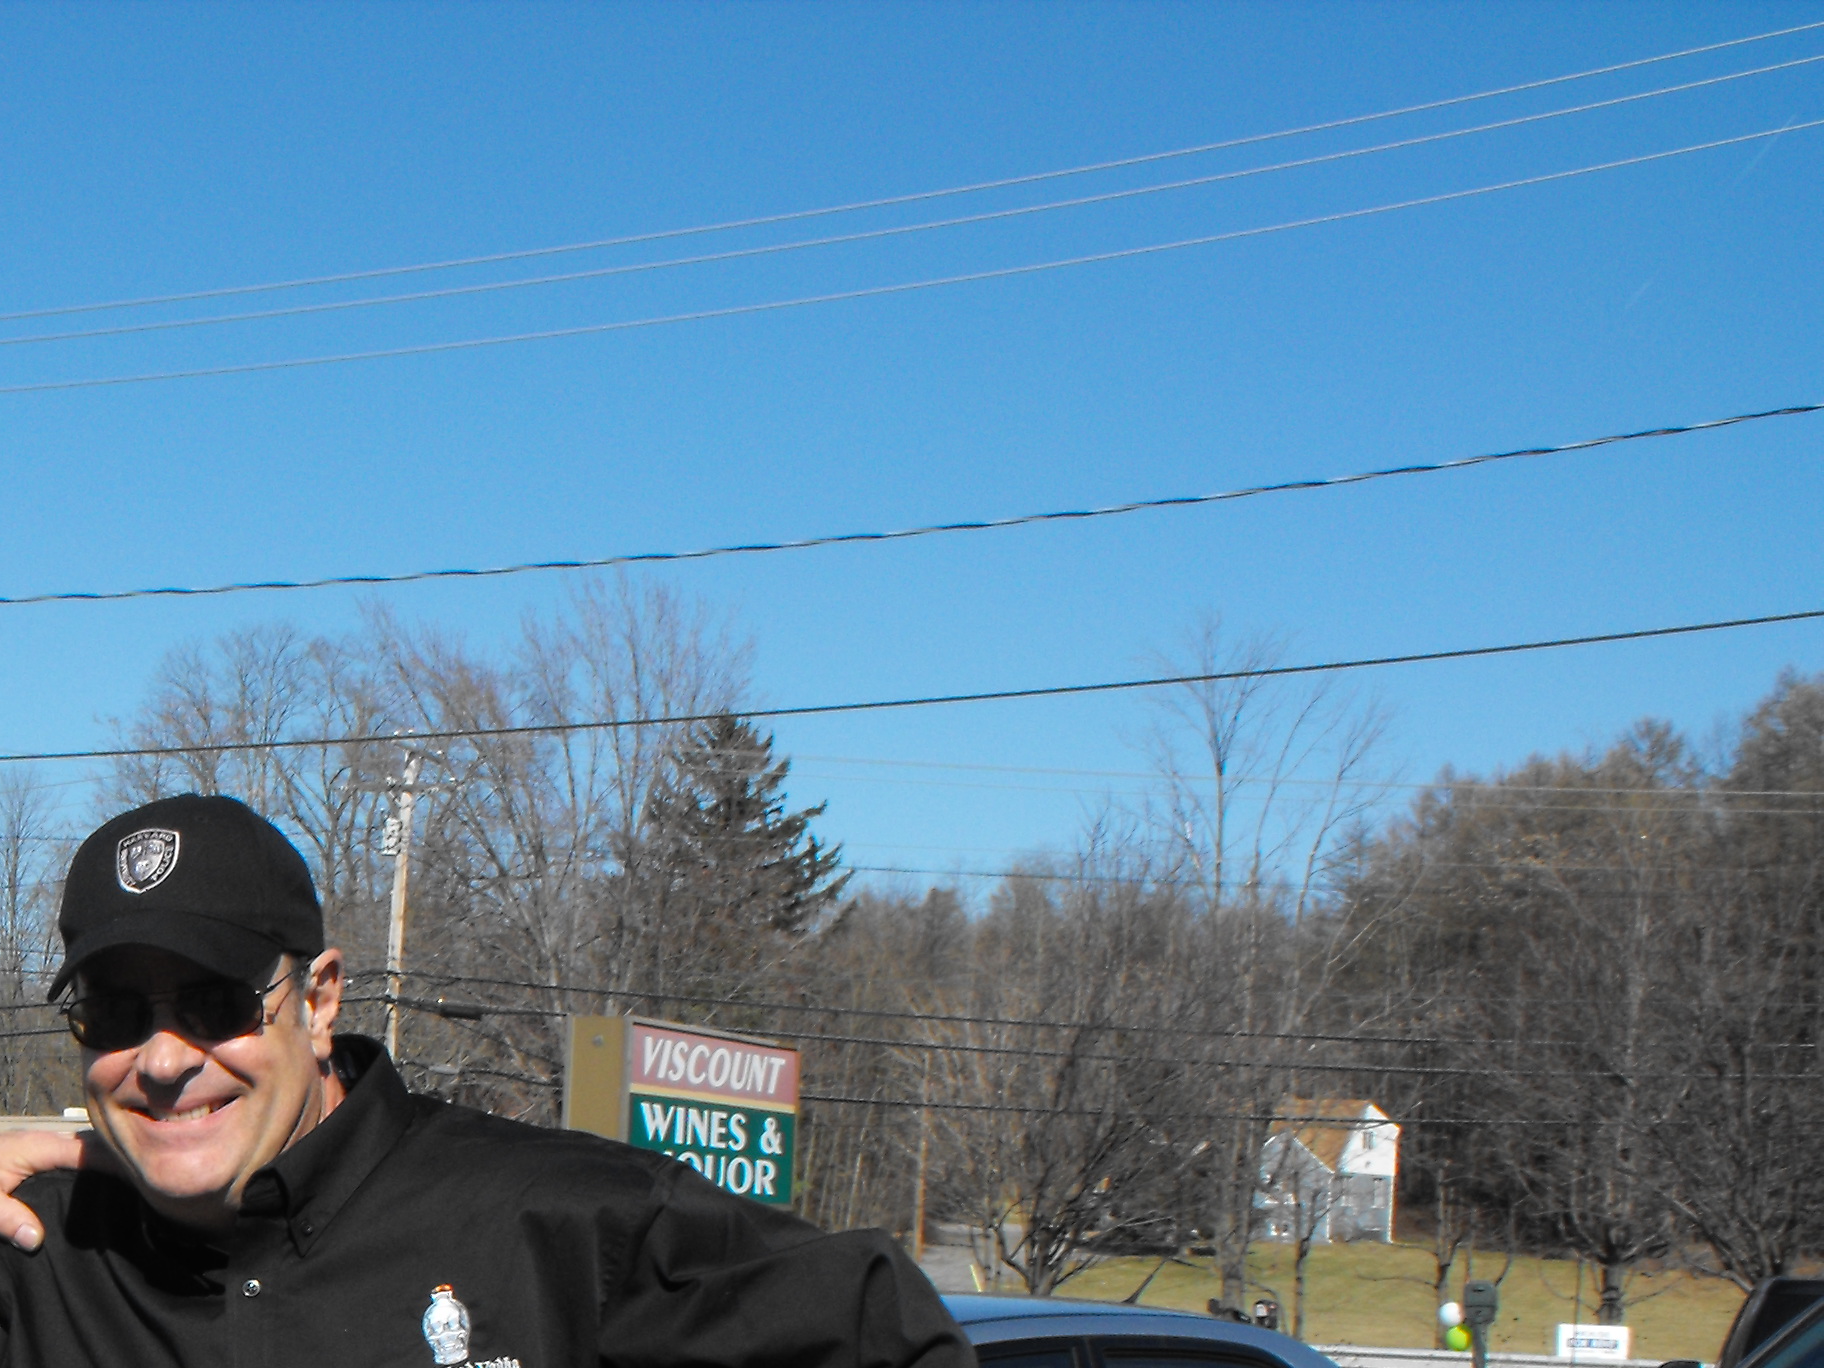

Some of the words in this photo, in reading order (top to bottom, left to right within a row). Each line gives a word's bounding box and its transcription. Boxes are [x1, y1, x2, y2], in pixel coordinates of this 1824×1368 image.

[644, 1036, 785, 1094] VISCOUNT
[640, 1101, 746, 1151] WINES
[760, 1117, 782, 1155] &
[663, 1150, 776, 1196] UOR
